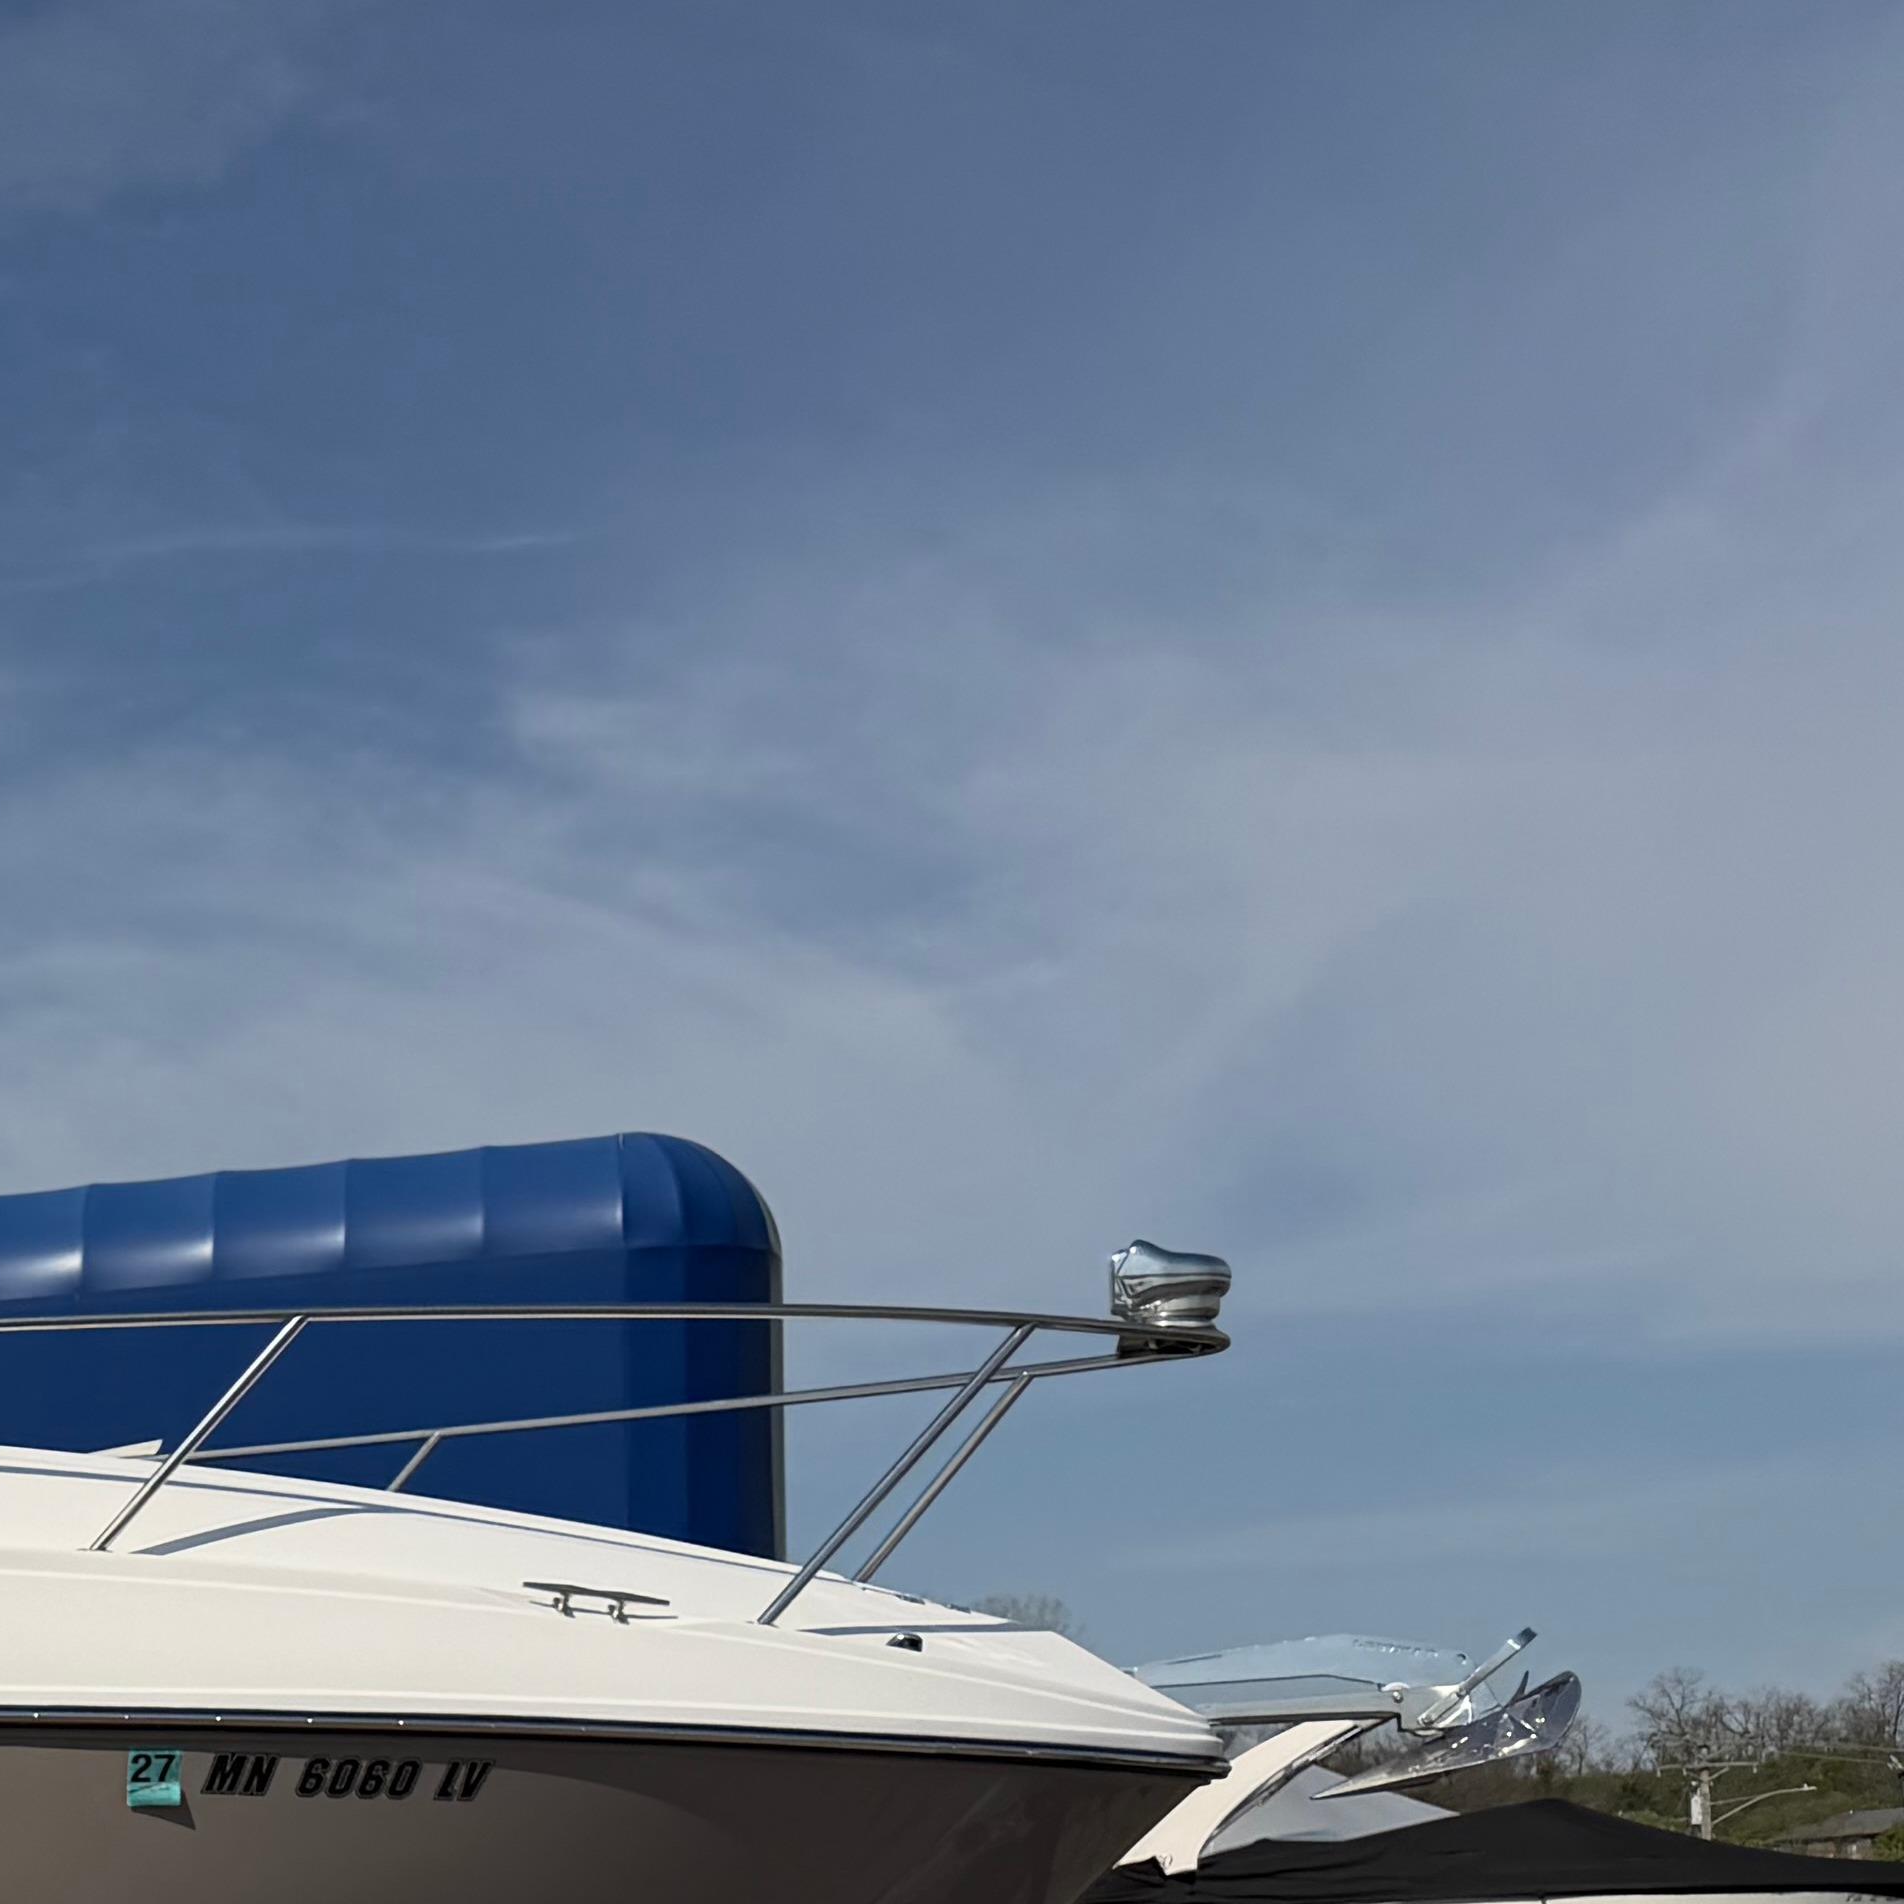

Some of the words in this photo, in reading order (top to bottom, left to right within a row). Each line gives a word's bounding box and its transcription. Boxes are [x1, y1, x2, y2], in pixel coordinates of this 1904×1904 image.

[130, 1753, 176, 1783] 27
[200, 1752, 282, 1796] MN
[295, 1757, 424, 1799] 6060
[434, 1759, 496, 1802] LV
